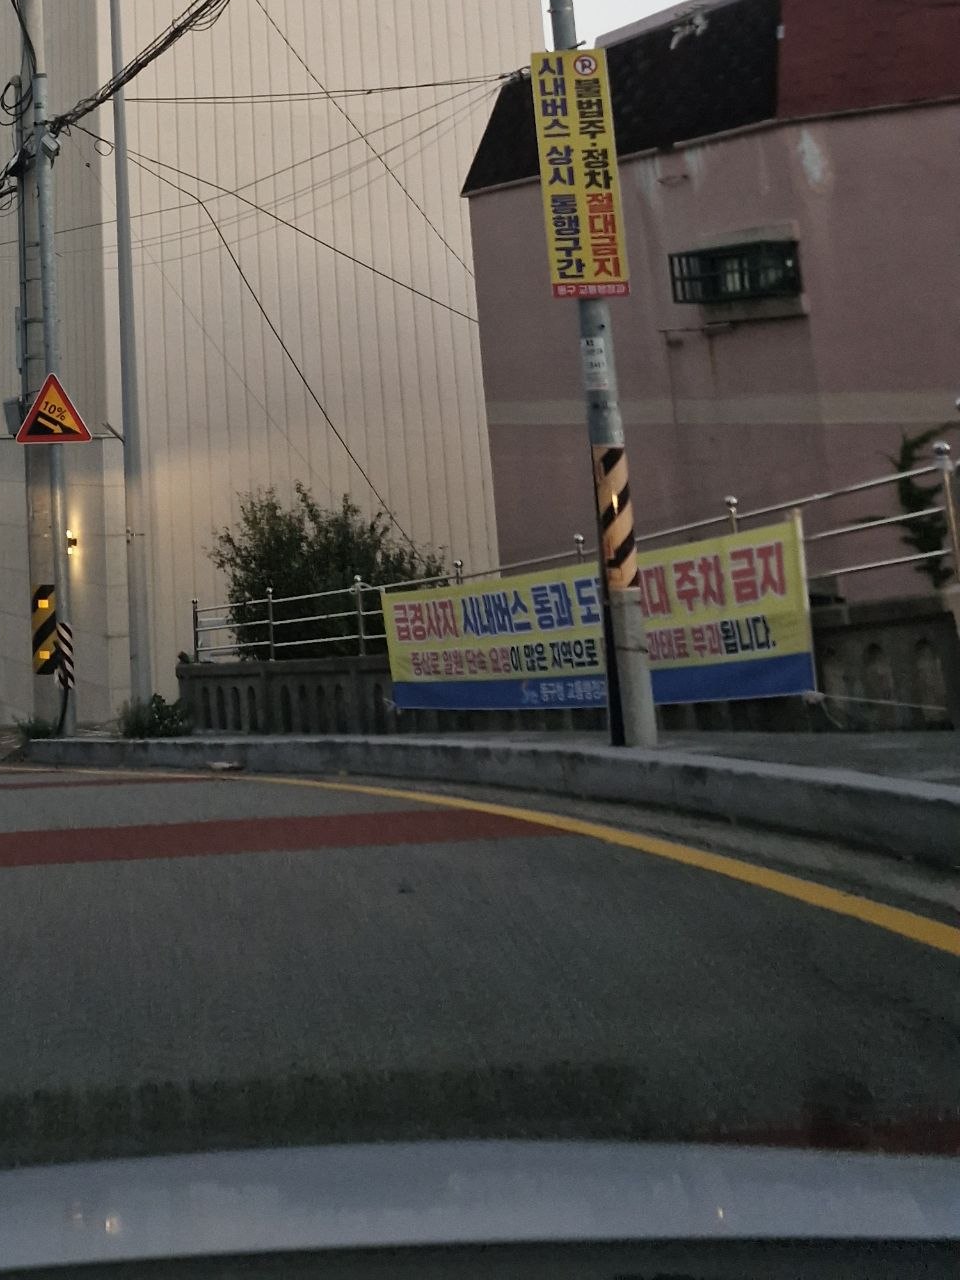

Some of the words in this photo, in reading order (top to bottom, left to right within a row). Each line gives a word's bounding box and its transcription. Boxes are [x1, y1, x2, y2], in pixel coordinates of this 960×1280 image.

[538, 57, 571, 138] 시내버스
[546, 146, 575, 186] 상시
[550, 193, 585, 279] 통행구간
[586, 192, 621, 277] 절대금지
[43, 401, 66, 421] 10%
[461, 590, 533, 637] 시내버스
[531, 582, 576, 631] 통과
[640, 566, 672, 618] 대
[674, 555, 726, 612] 주차
[730, 541, 786, 604] 금지
[524, 642, 548, 672] 많은
[549, 639, 599, 670] 지역으로
[646, 627, 690, 662] 과태료
